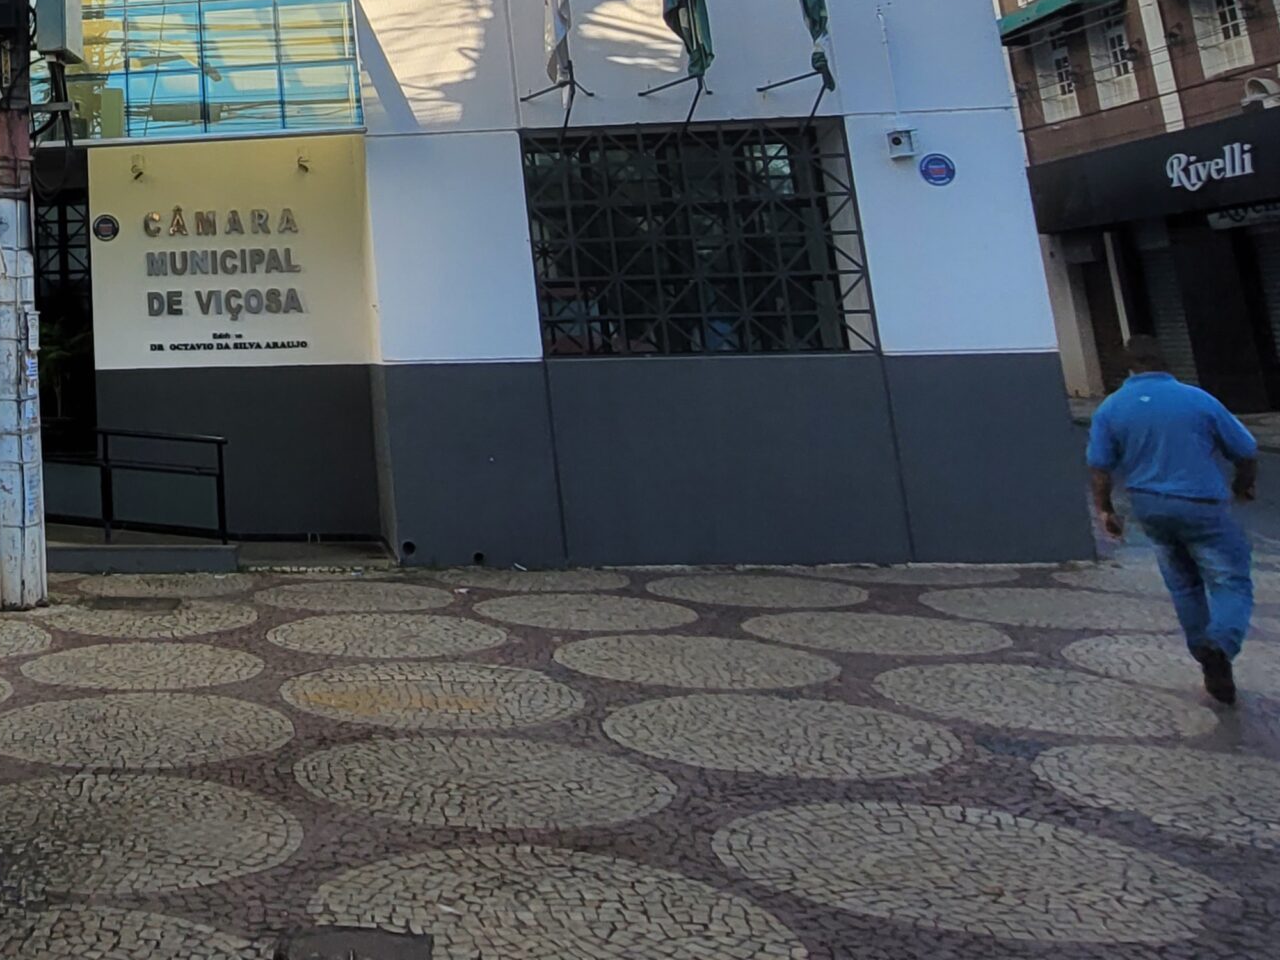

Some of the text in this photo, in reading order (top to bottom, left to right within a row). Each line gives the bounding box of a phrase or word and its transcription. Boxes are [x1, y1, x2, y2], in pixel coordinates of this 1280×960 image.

[1166, 142, 1255, 191] Rivelli
[143, 205, 299, 237] CÂMARA
[146, 247, 302, 276] MUNICIPAL
[147, 288, 303, 321] DE VIÇOSA
[169, 343, 214, 351] OCTAVIO
[216, 342, 231, 350] DA
[233, 341, 262, 350] SILVA
